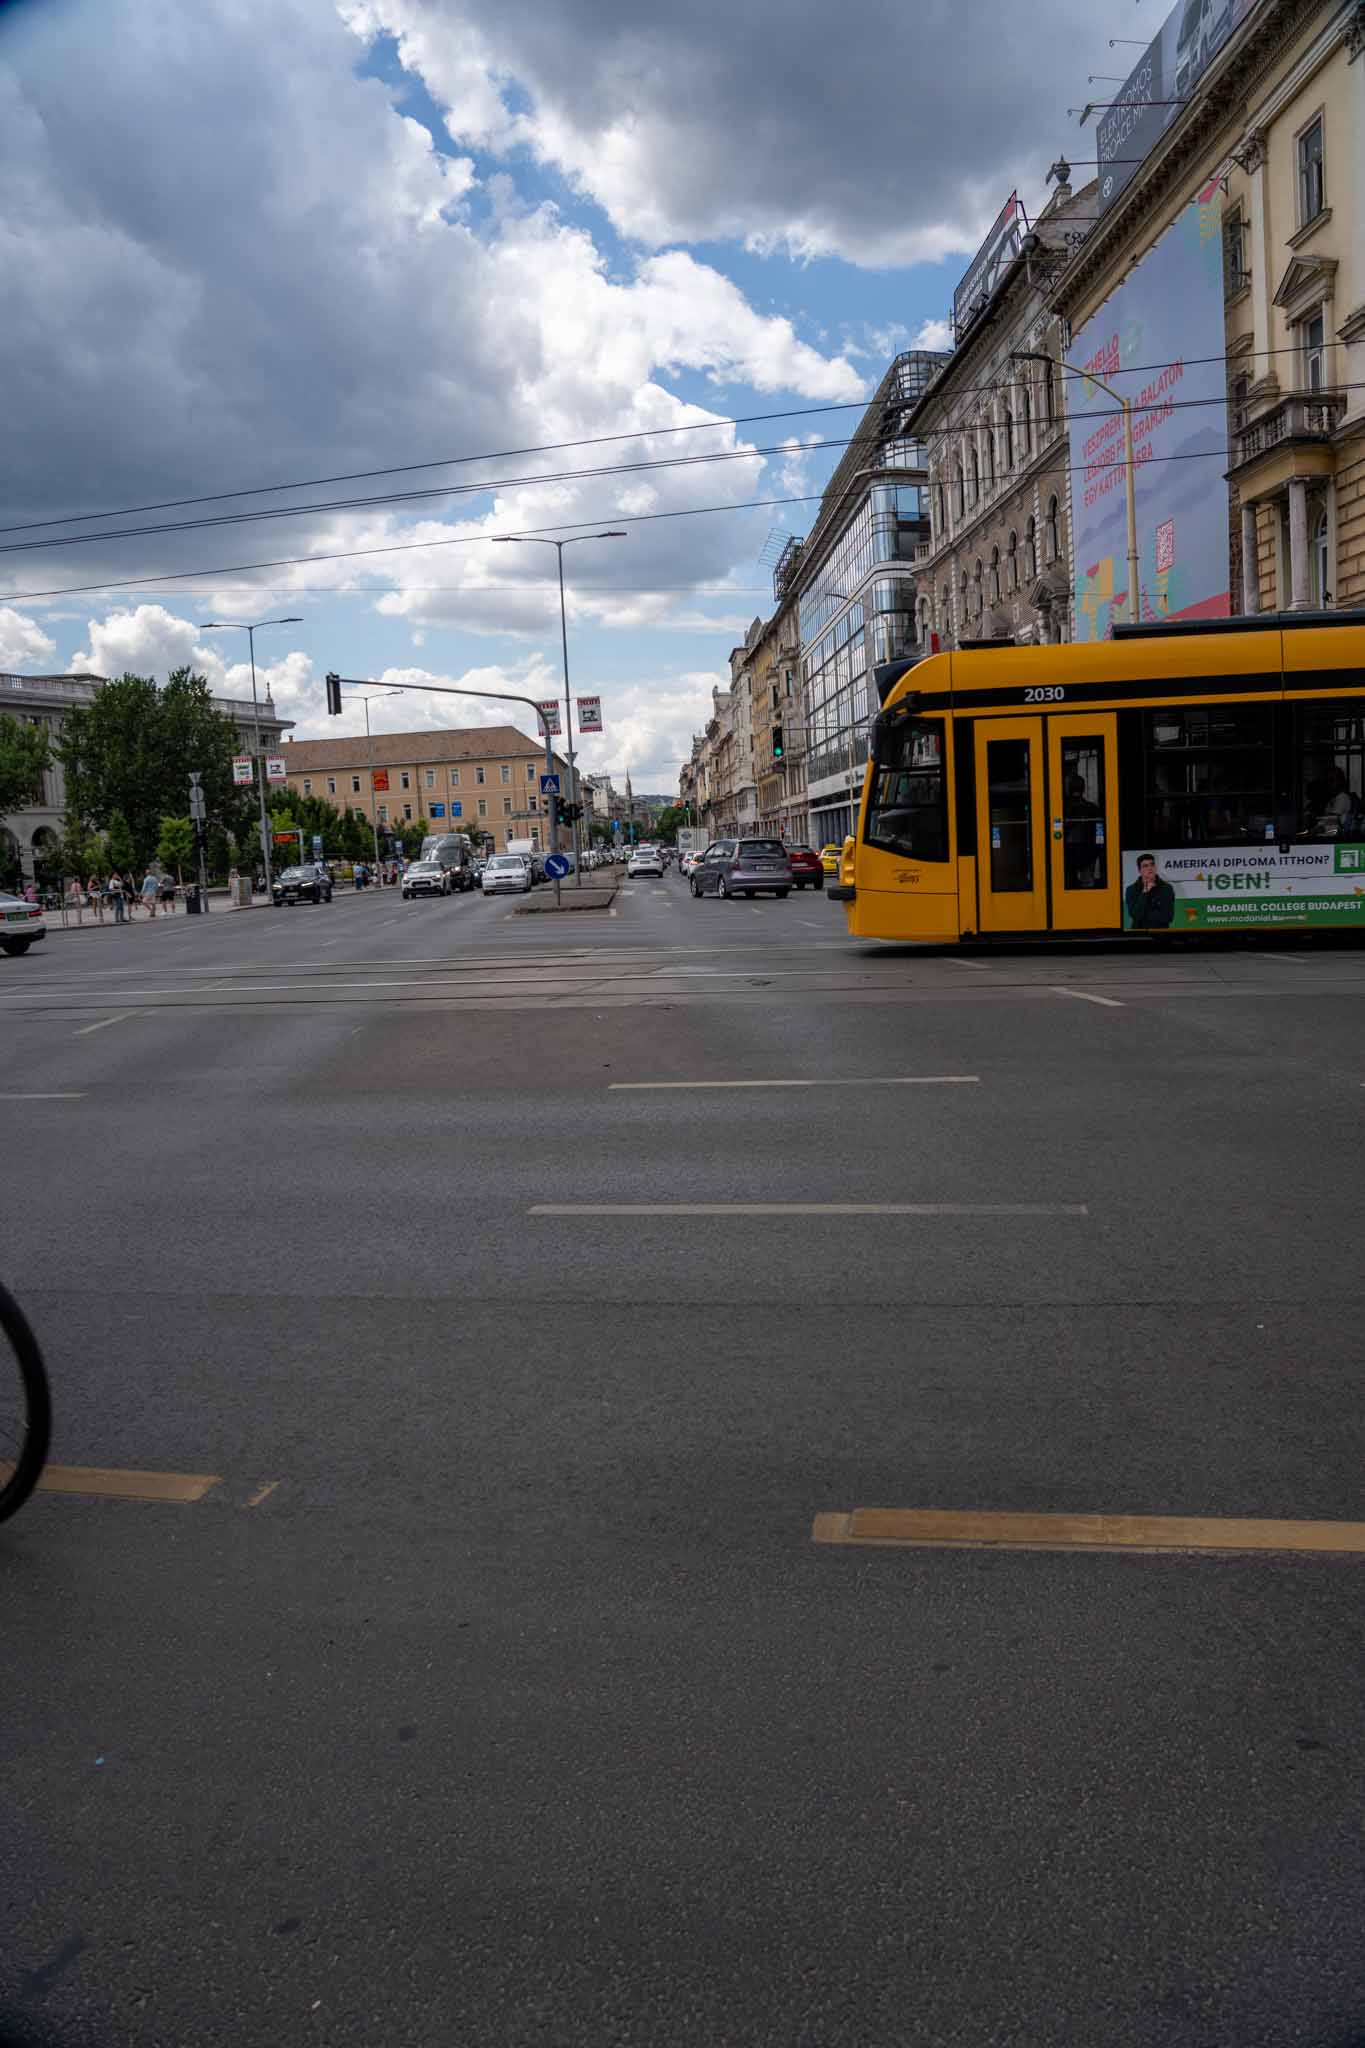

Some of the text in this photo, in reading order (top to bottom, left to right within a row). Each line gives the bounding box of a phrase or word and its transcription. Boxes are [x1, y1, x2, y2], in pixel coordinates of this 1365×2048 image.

[1100, 57, 1153, 144] ELEKTROMOS
[1140, 355, 1184, 409] BALATON
[1116, 394, 1174, 451] PGRAMJAI
[1098, 441, 1153, 497] KATTINSRA
[1024, 686, 1064, 702] 2030
[1164, 855, 1330, 869] AMERIKAI DIPLOMA ITTHON?
[1207, 871, 1271, 891] IGEN!
[1206, 900, 1361, 913] McDANIEL COLLEGE BUDAPEST
